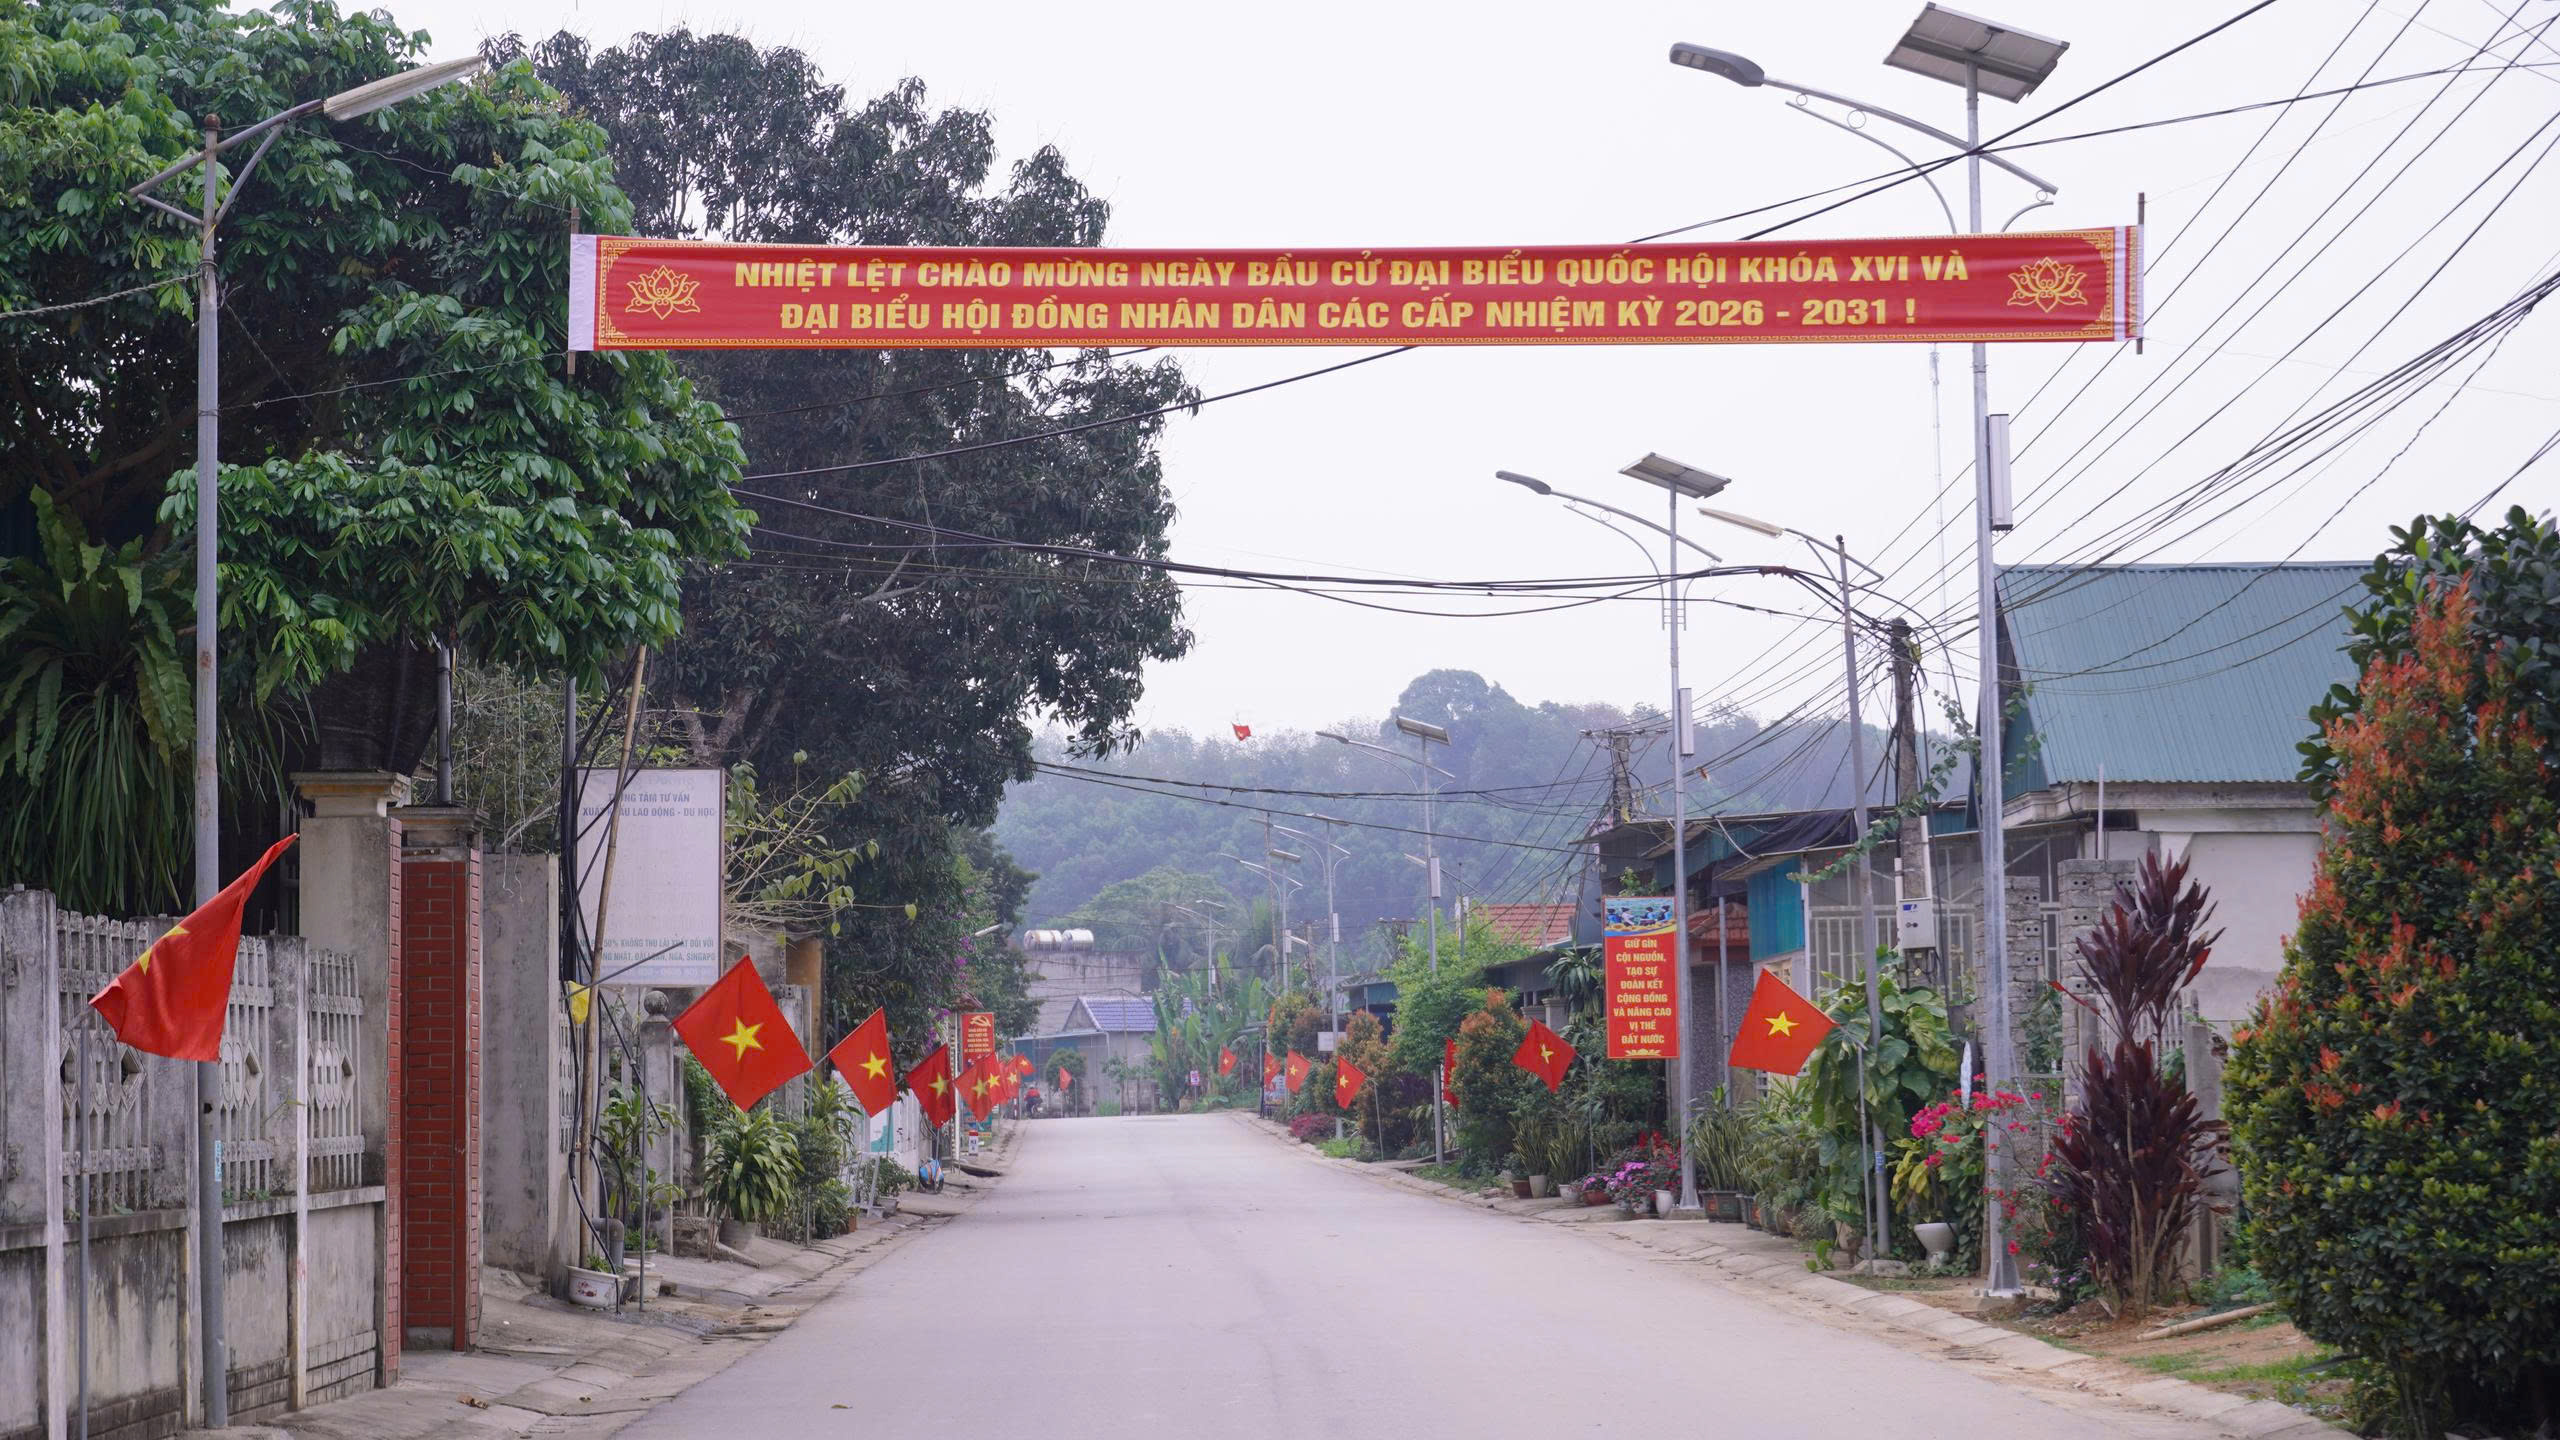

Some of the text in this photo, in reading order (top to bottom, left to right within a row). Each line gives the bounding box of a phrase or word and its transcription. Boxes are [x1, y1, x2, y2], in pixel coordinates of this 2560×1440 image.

[735, 249, 1969, 293] NHIỆT LỆT CHÀO MỪNG NGÀY BẦU CỬ ĐẠI BIỂU QUỐC HỘI KHÓA XVI VÀ
[780, 303, 839, 334] ĐẠI
[851, 293, 930, 329] BIỂU
[943, 298, 1001, 335] HỘI
[1011, 294, 1109, 329] ĐỒNG
[1121, 298, 1220, 329] NHÂN
[1233, 298, 1305, 329] DÂN
[1318, 297, 1390, 328] CÁC
[1402, 292, 1474, 328] CẤP
[1486, 296, 1605, 333] NHIỆM
[1618, 295, 1664, 327] KỲ
[1674, 299, 1764, 326] 2026
[1800, 298, 1887, 325] 2031
[1905, 298, 1916, 324] !
[1624, 938, 1640, 948] GIỮ
[1626, 966, 1658, 977] TẠO SỰ
[1647, 977, 1664, 989] KẾT
[1617, 992, 1641, 1004] CỘNG
[1613, 1006, 1625, 1017] VÀ
[1654, 1007, 1672, 1016] CAO
[1629, 1018, 1656, 1032] VỊ THẾ
